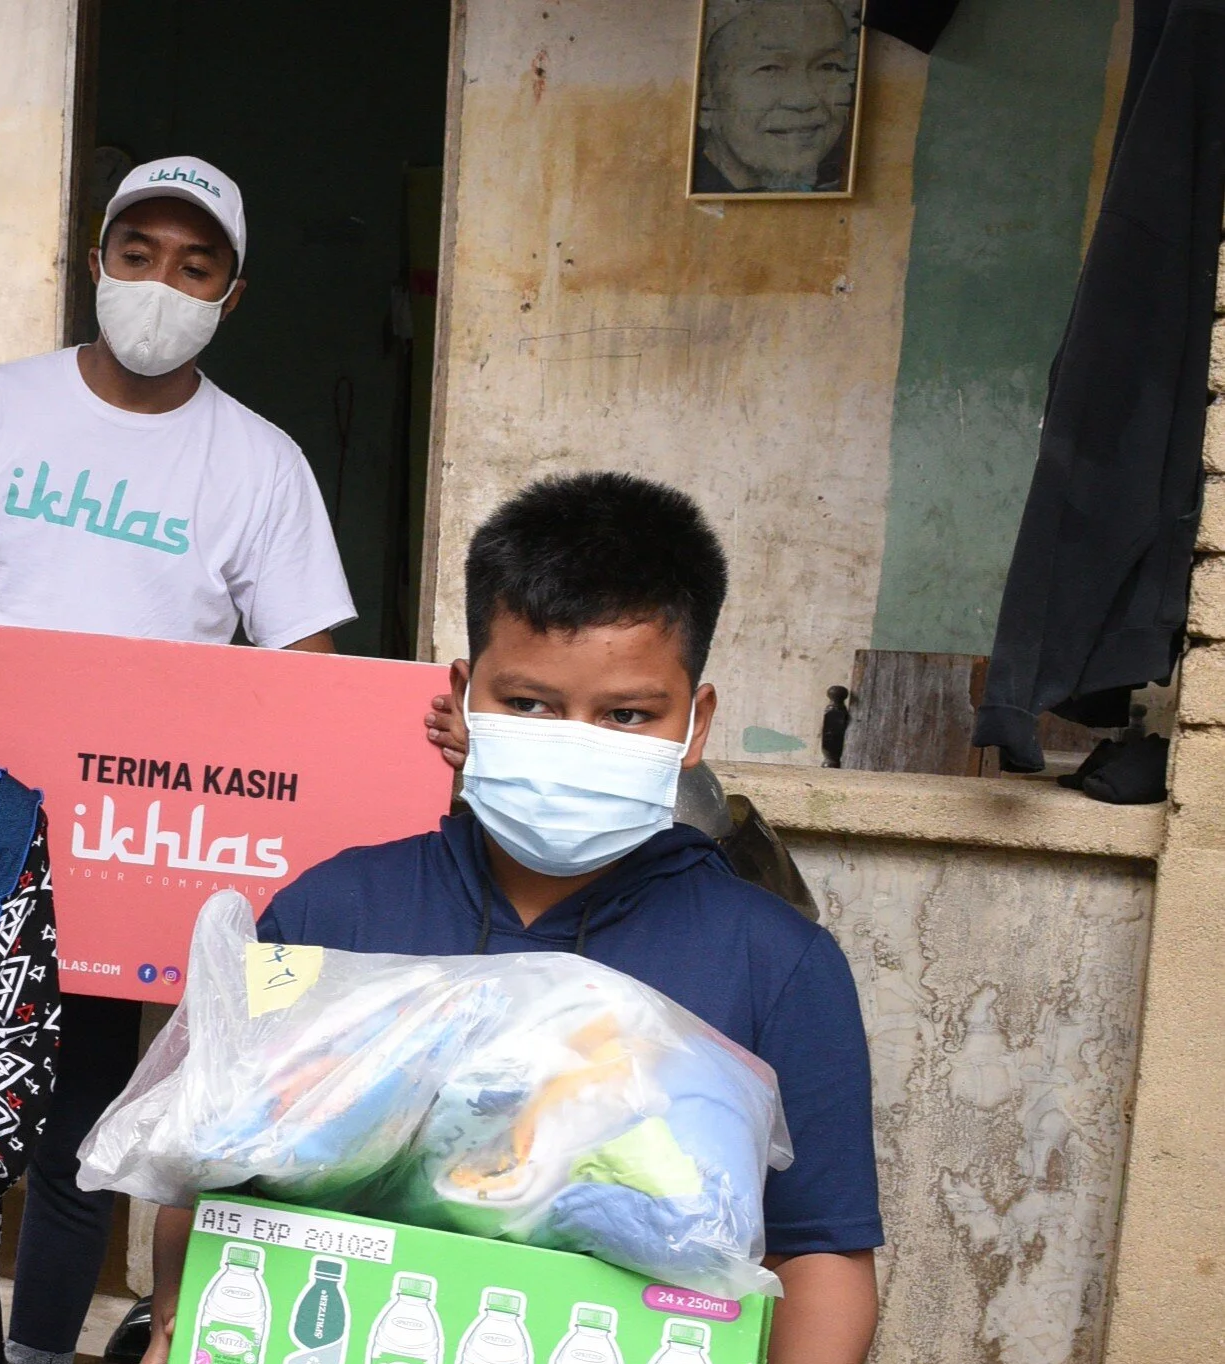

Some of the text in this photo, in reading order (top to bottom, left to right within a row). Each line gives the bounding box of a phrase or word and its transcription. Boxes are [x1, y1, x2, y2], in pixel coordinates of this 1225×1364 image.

[149, 167, 221, 198] ikhlas
[5, 461, 190, 555] ikhlas
[77, 753, 298, 802] TERIMA KASIH
[71, 795, 289, 878] ikhlas
[69, 867, 125, 881] YOUR
[202, 1208, 389, 1261] A15 EXP 201022
[657, 1291, 728, 1313] 24 x 250ml
[207, 1333, 251, 1349] SPRITZER
